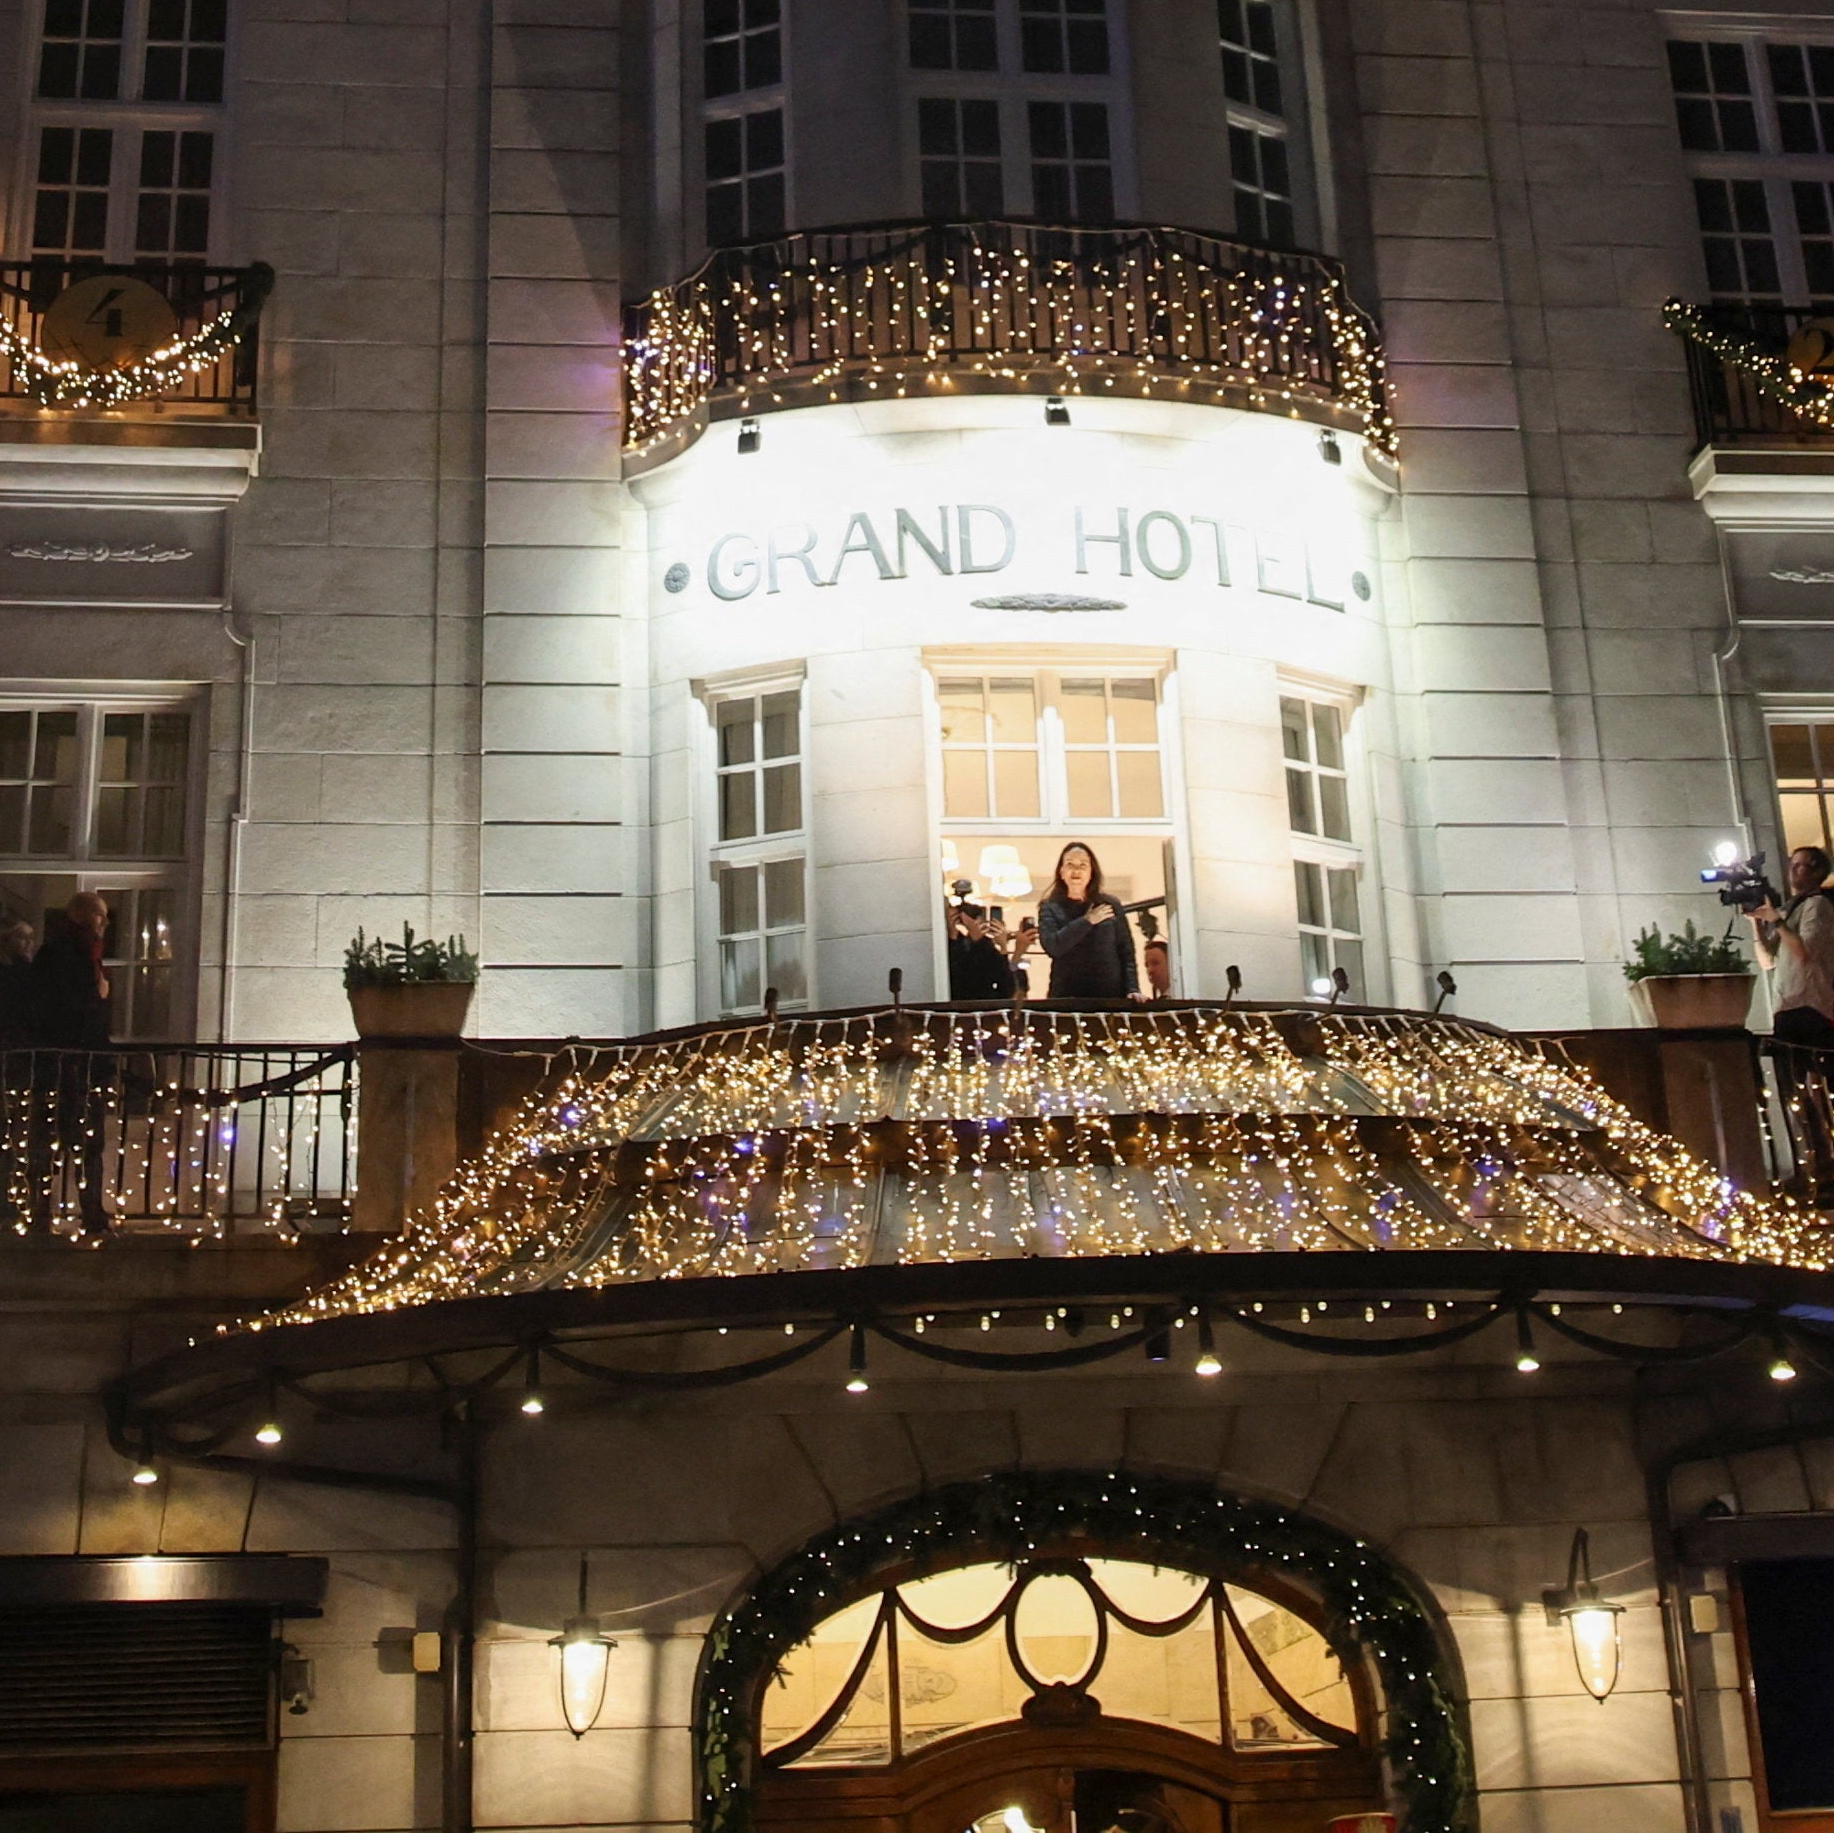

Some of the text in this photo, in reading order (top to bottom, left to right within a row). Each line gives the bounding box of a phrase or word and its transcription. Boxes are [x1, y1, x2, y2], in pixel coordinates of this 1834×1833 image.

[84, 288, 124, 338] 4
[707, 504, 1346, 613] GRAND HOTEL
